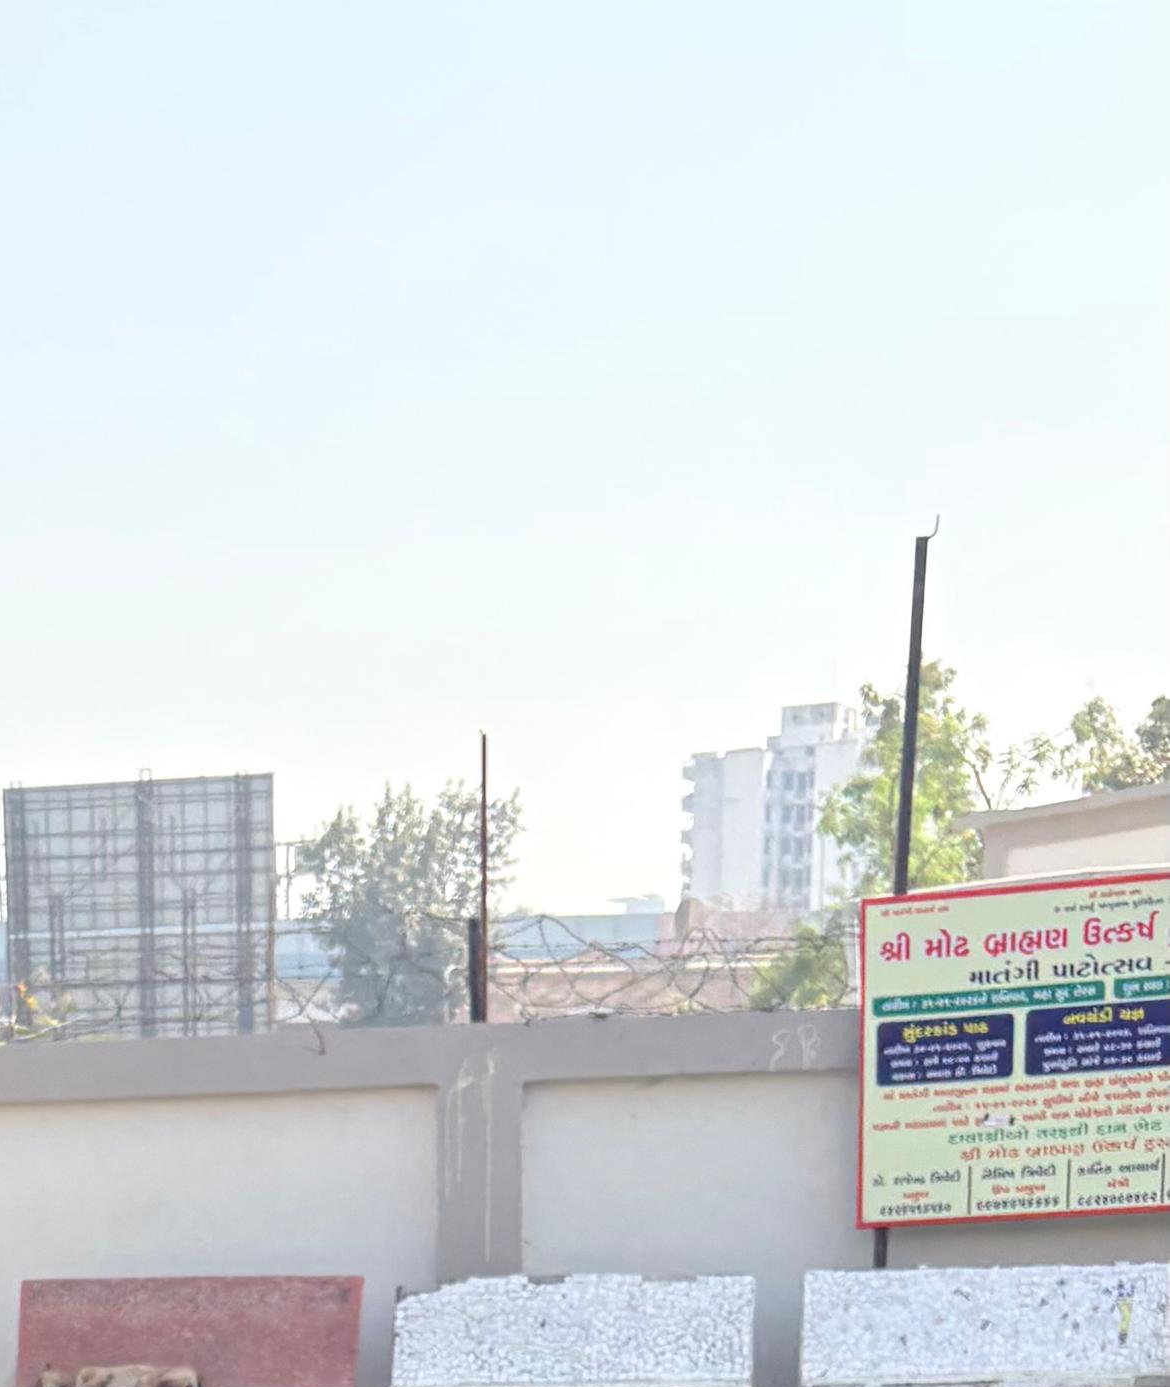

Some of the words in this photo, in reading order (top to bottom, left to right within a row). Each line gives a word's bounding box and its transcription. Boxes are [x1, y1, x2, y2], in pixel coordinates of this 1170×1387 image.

[879, 931, 910, 961] શ્રી
[983, 927, 1068, 957] બ્રાહ્મણ
[1082, 910, 1160, 946] ઉત્કર્ષ
[969, 959, 1039, 985] માતંગી
[1052, 953, 1153, 978] પાટોત્સવ
